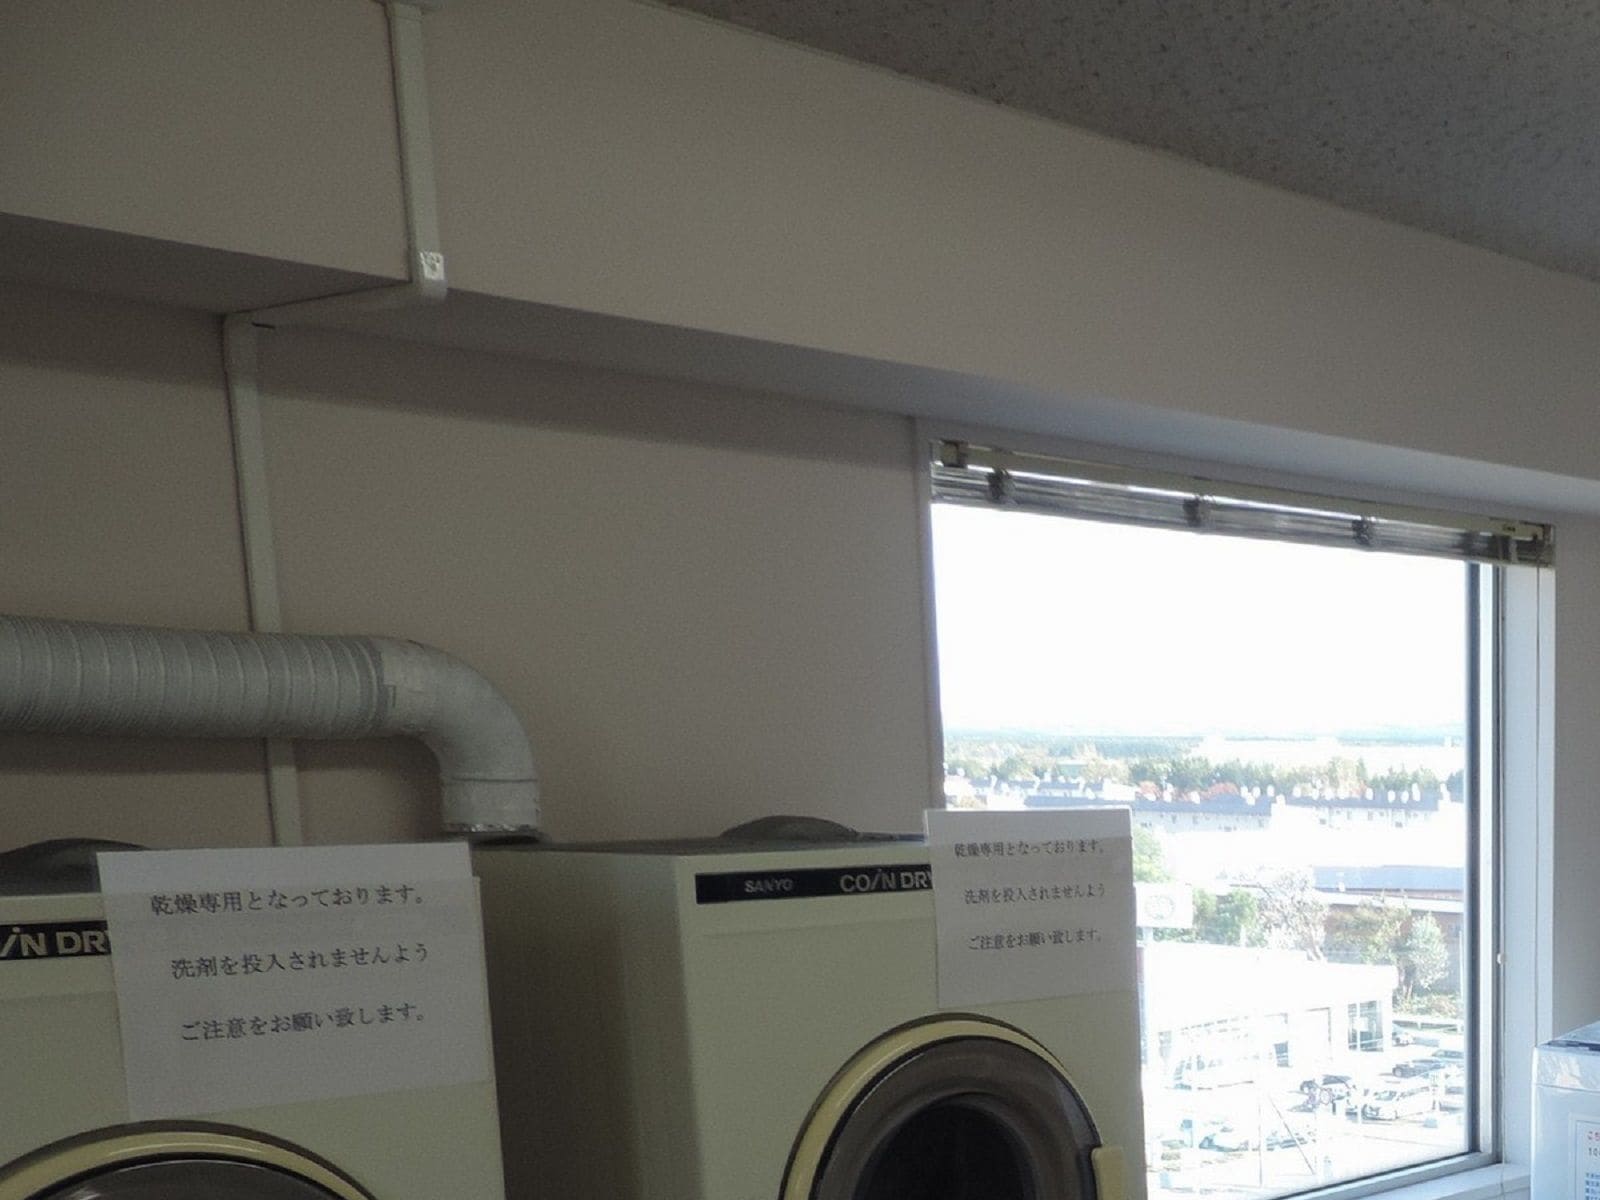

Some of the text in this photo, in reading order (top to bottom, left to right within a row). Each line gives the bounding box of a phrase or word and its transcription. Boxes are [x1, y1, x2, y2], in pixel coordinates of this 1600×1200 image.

[954, 839, 1105, 858] 乾燥専用となっております。
[743, 877, 794, 894] SANYO
[839, 867, 932, 893] COIN DR
[150, 883, 424, 916] 乾燥専用となっております。
[964, 883, 1106, 905] 洗剤を投入されませんよう
[55, 929, 111, 955] DR
[968, 928, 1103, 951] ご注意をお願い致します。
[171, 942, 429, 981] 洗剤を投入されませんよう
[181, 1002, 425, 1042] ご注意をお願い致します。
